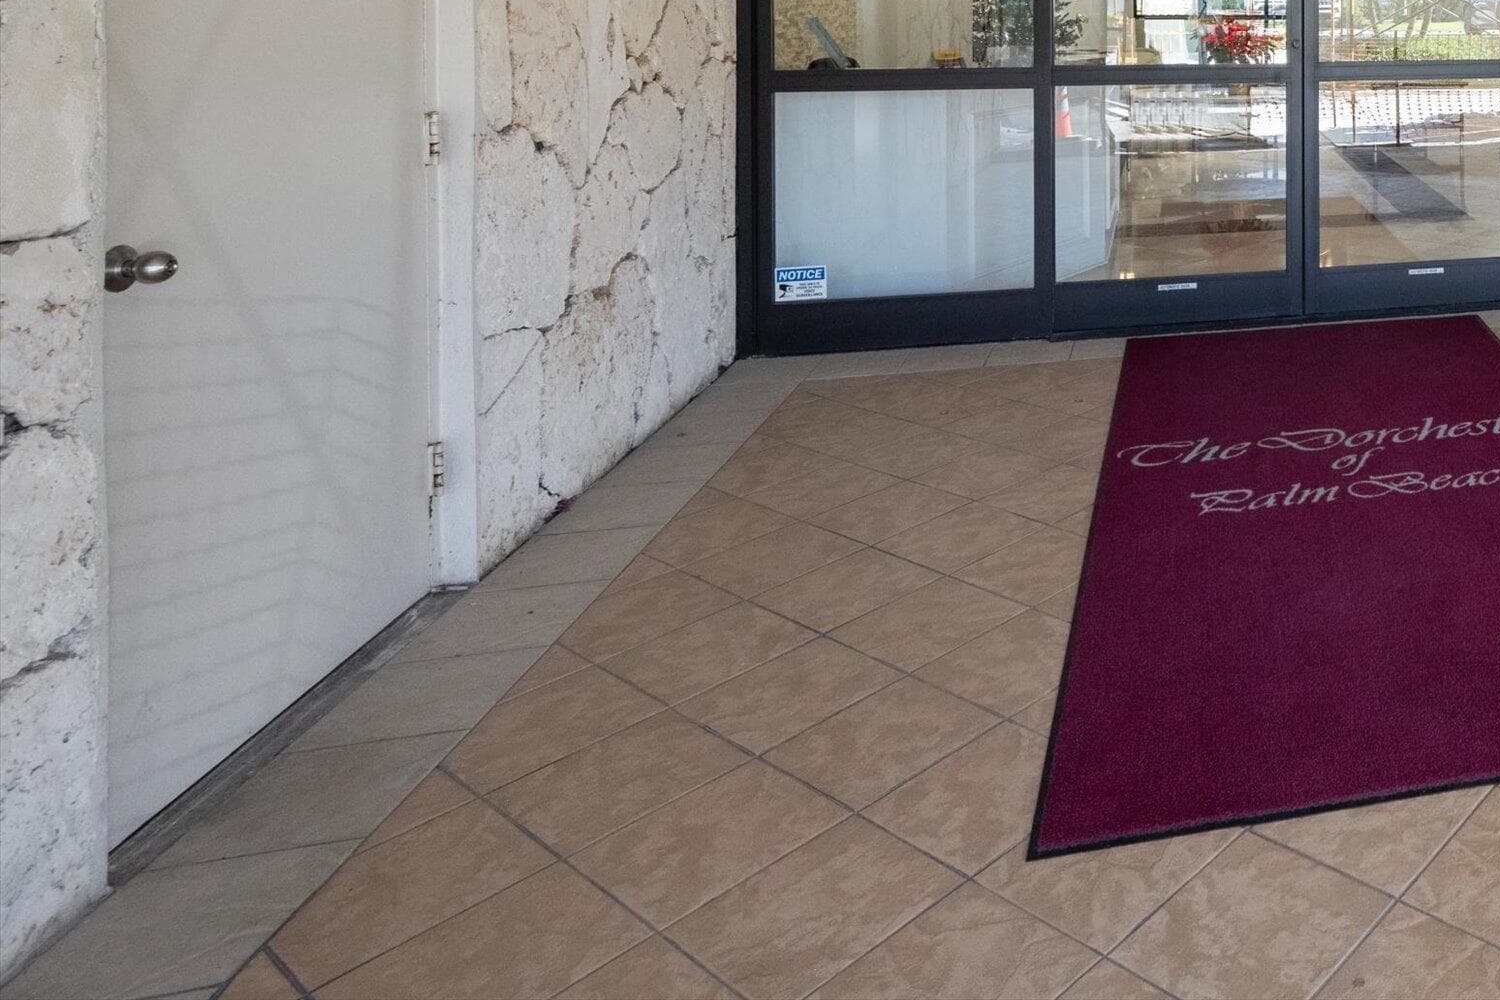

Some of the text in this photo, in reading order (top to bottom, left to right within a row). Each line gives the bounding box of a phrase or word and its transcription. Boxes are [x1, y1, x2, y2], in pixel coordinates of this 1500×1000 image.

[778, 269, 823, 281] NOTICE
[1117, 436, 1251, 466] The
[1331, 446, 1385, 476] of
[1190, 482, 1340, 516] Palm
